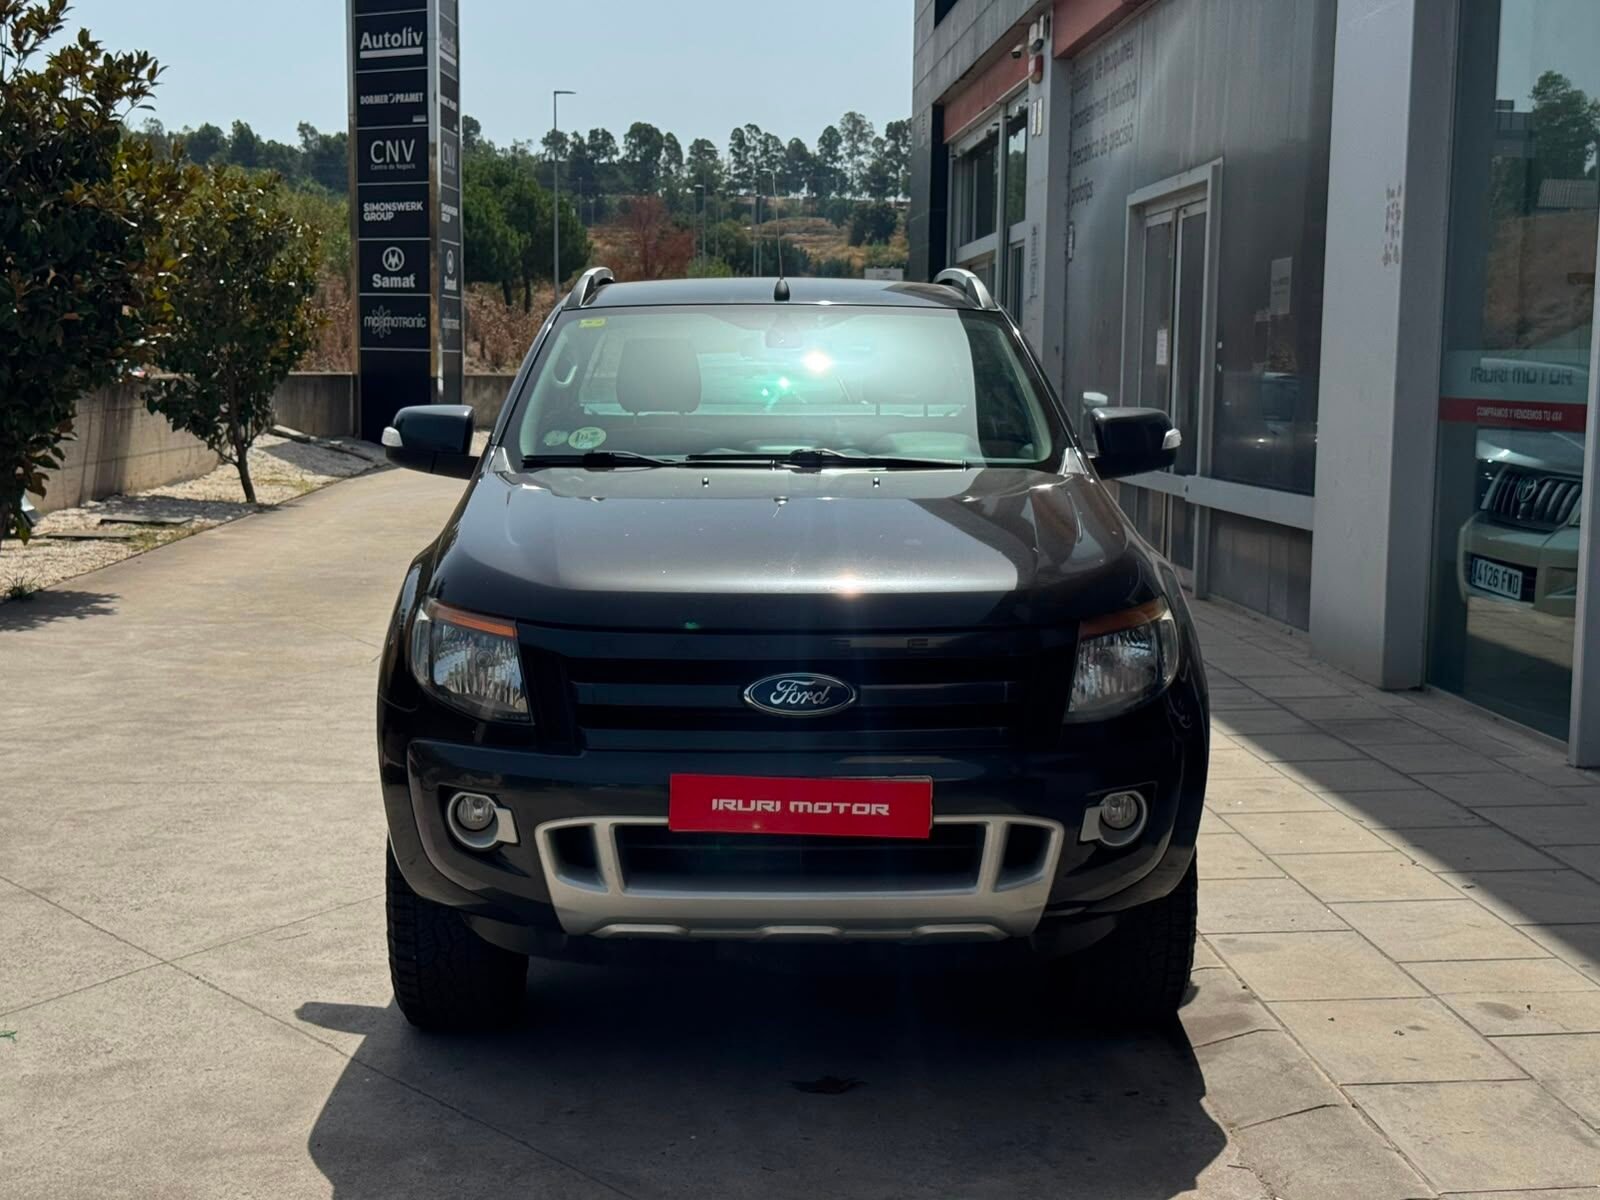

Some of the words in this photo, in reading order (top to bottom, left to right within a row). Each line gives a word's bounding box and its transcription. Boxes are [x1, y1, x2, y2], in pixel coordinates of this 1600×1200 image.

[360, 27, 423, 49] Autoliv
[360, 94, 389, 105] DORMER
[396, 92, 424, 103] PRAMET
[370, 139, 415, 163] CNV
[363, 201, 423, 212] SIMONSWERK
[363, 211, 394, 222] GROUP
[372, 273, 416, 288] Samat
[1470, 366, 1509, 385] IRURI
[1512, 367, 1574, 386] MOTOR
[770, 680, 831, 704] Ford
[711, 798, 781, 813] IRURI
[789, 801, 890, 816] MOTOR
